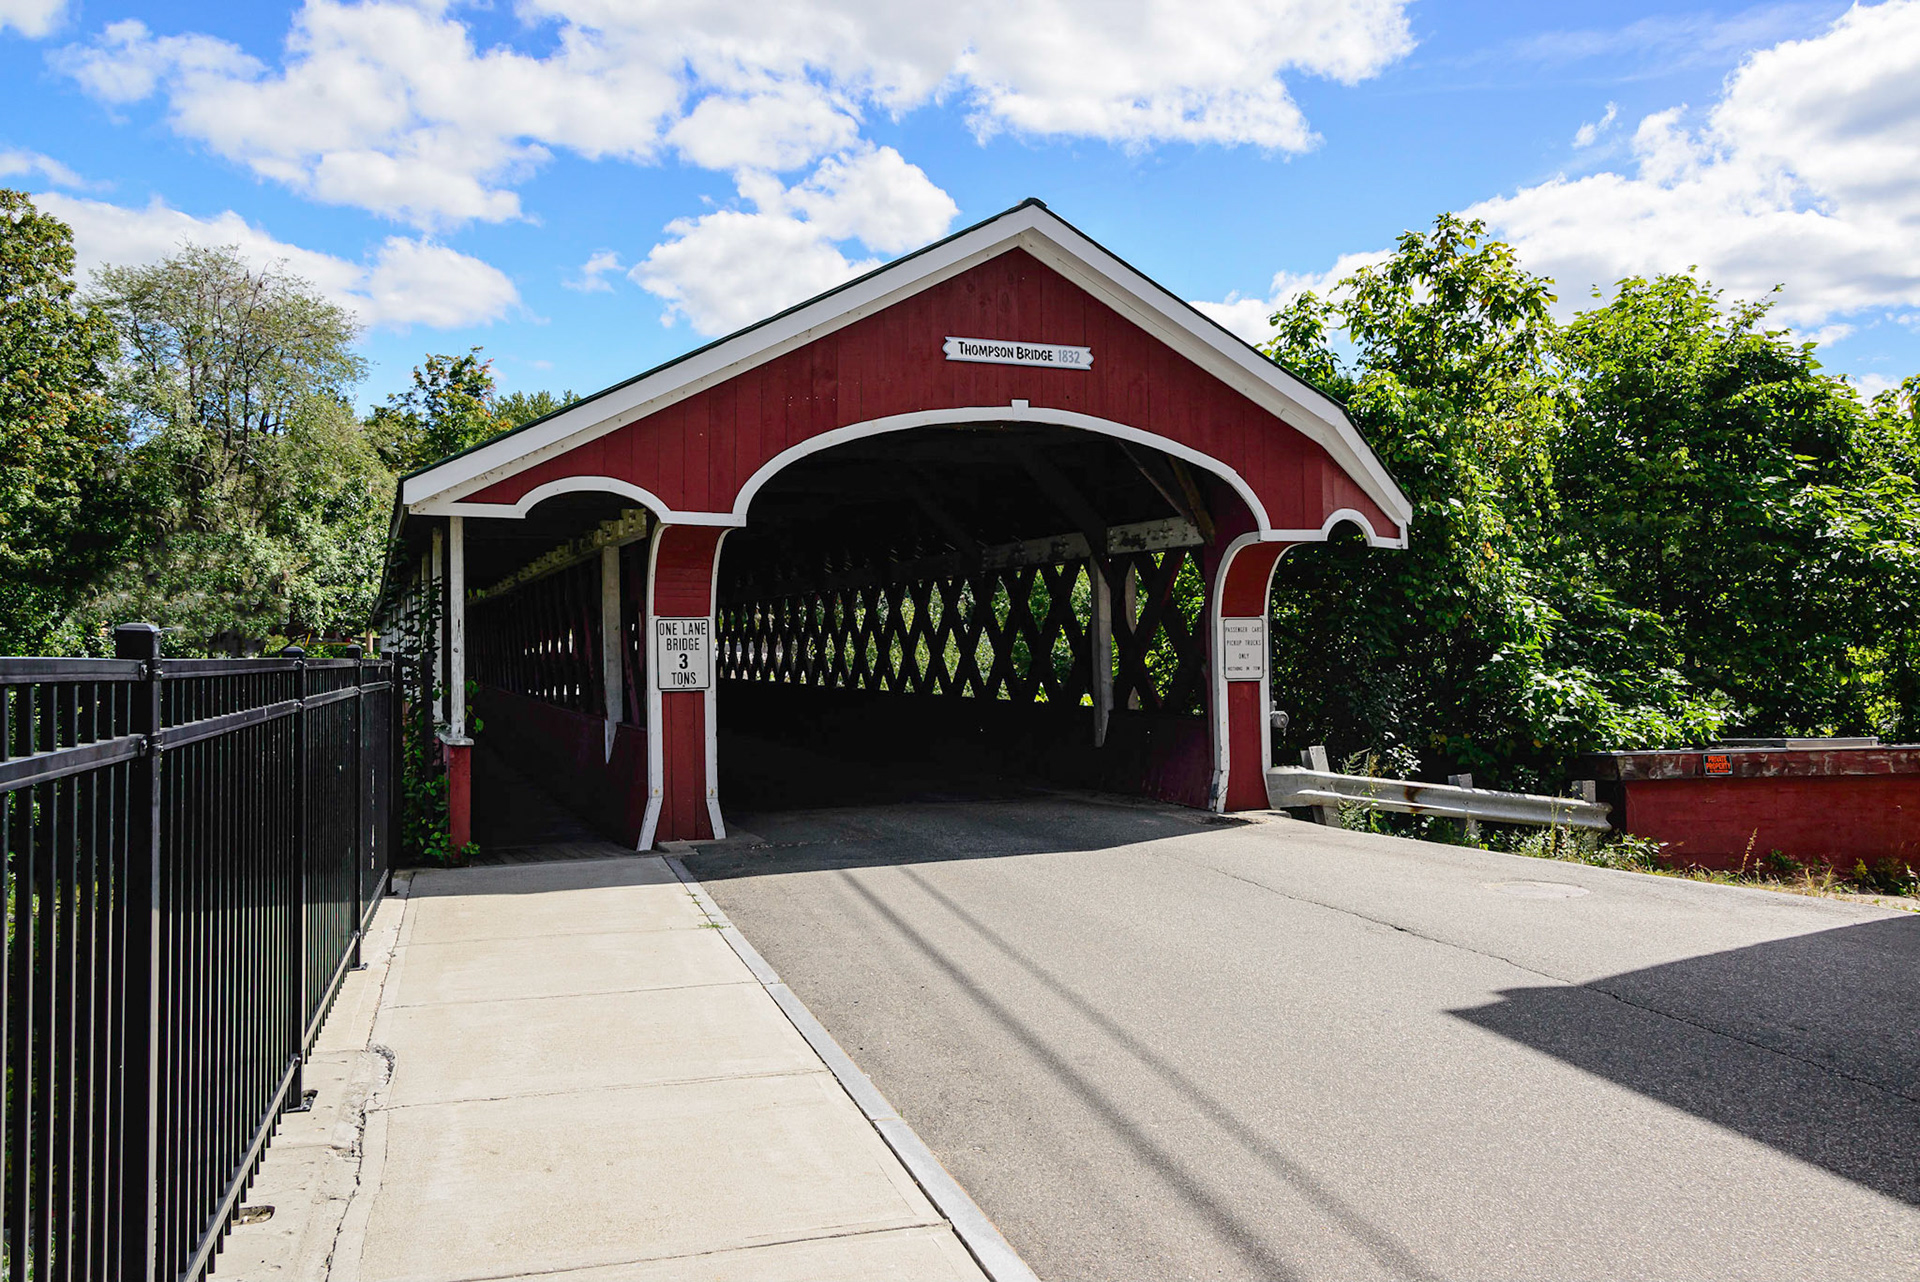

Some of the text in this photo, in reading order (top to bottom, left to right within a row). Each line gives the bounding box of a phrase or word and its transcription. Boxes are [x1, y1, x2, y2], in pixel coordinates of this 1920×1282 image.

[958, 341, 1080, 364] THOMPSON BRIDGE 1832
[659, 622, 706, 636] ONE LANE
[666, 638, 700, 651] BRIDGE
[679, 653, 688, 669] 3
[671, 671, 697, 685] TONS
[1705, 762, 1731, 770] PROPERTY
[1707, 755, 1727, 763] PRIVATE
